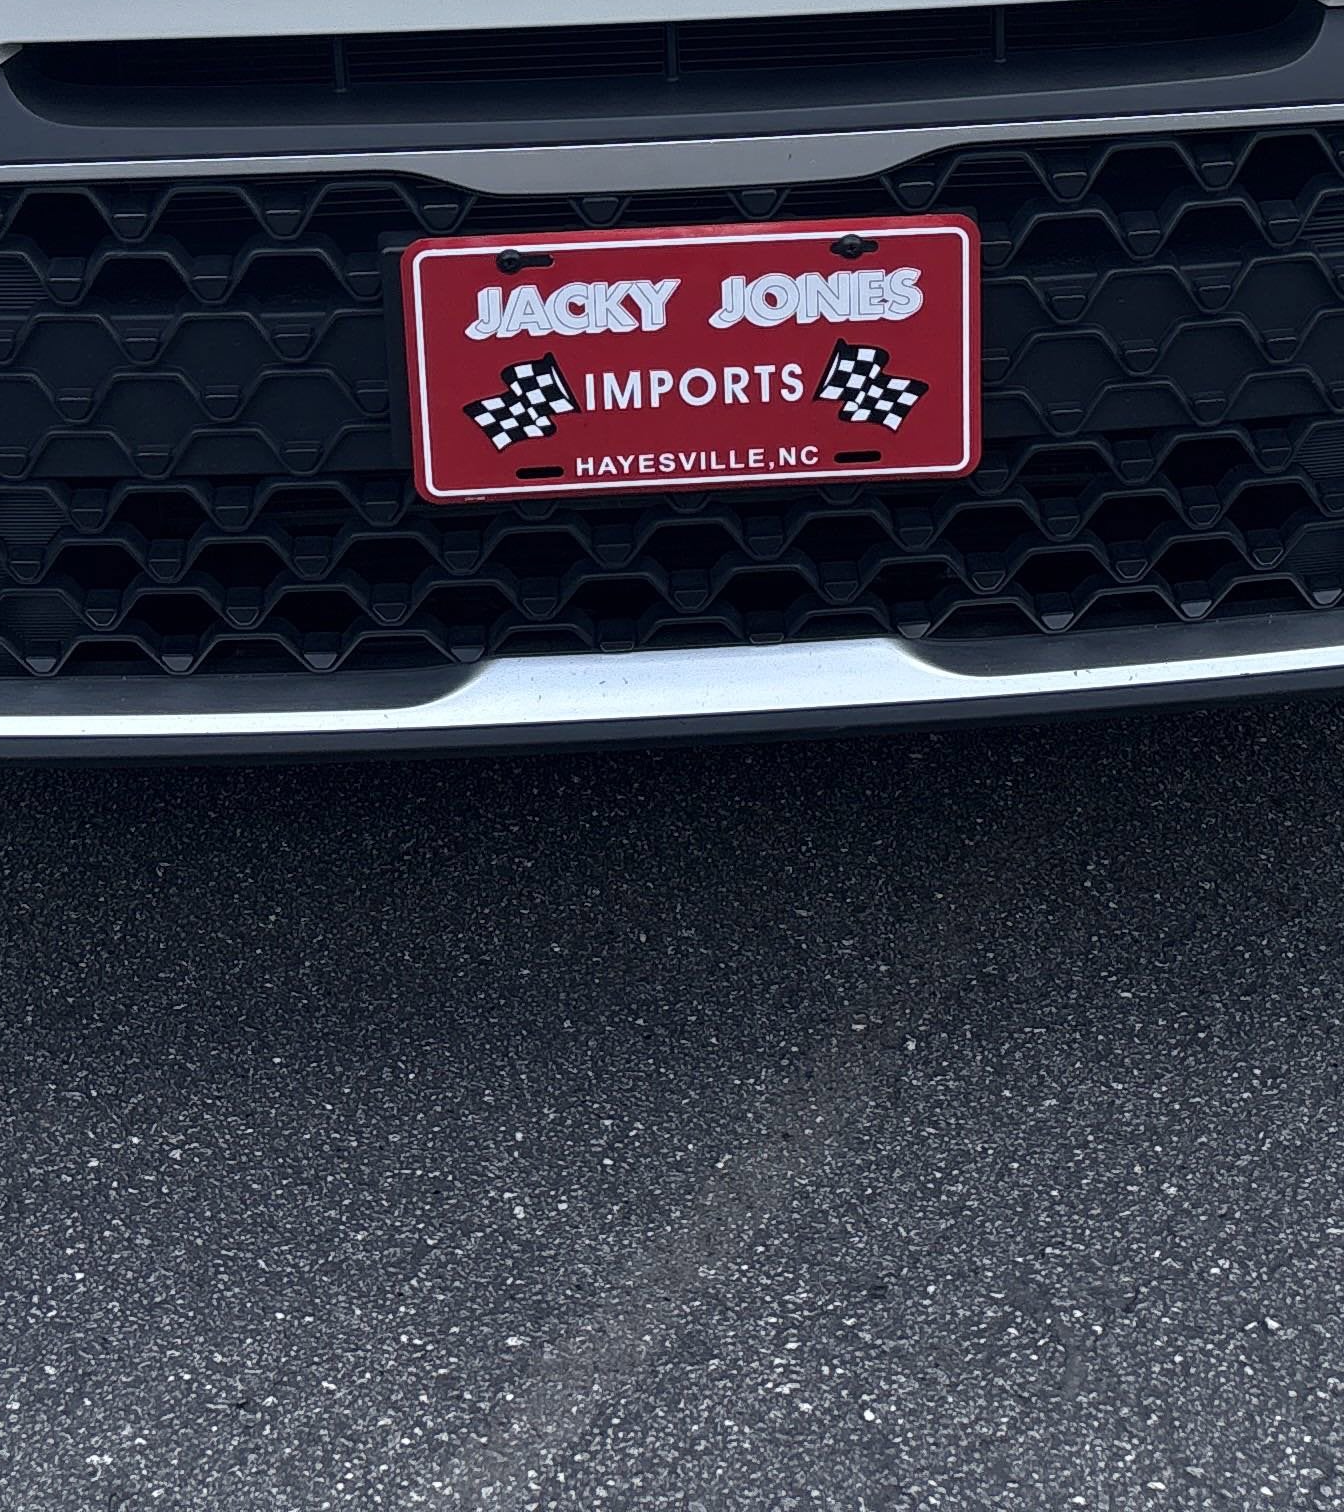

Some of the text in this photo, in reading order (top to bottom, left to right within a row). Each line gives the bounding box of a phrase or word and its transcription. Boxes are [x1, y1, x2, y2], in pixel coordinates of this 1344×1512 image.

[464, 267, 924, 340] JACKY JONES
[584, 363, 805, 411] IMPORTS
